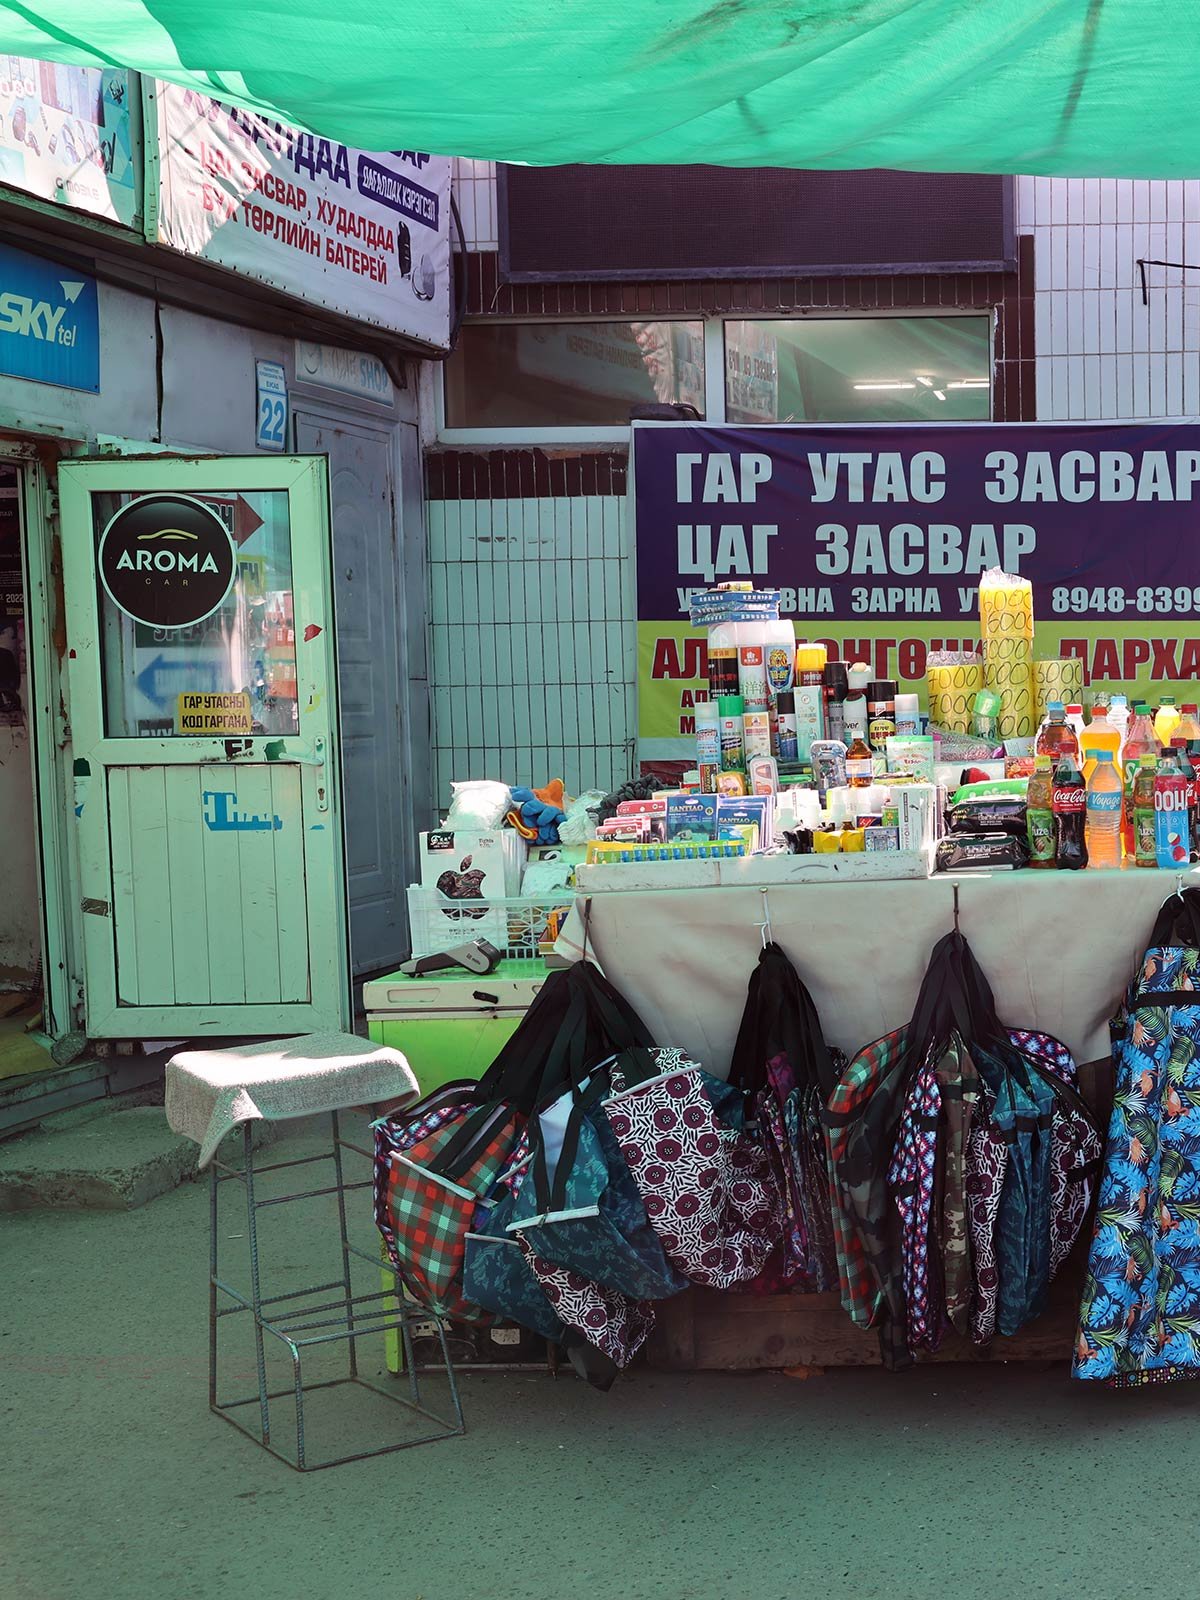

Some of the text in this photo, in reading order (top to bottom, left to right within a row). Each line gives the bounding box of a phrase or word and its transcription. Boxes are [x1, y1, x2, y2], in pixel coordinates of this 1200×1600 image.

[317, 196, 394, 253] ХУДАЛДАА
[242, 201, 321, 257] ТӨРЛИЙН
[325, 235, 387, 285] БАТЕРЕЙ
[260, 398, 285, 442] 22
[675, 452, 773, 504] ГАР
[810, 451, 947, 504] УТАС
[115, 549, 219, 574] AROMA
[676, 524, 1036, 582] ЦАГ ЗАСВАР
[145, 577, 189, 586] CAR
[764, 587, 835, 613] ВНА
[852, 587, 941, 613] ЗАРНА
[928, 666, 978, 690] 7000
[183, 695, 246, 709] ГАР УТАСНЫ
[182, 715, 249, 729] КОД ГАРГАНА
